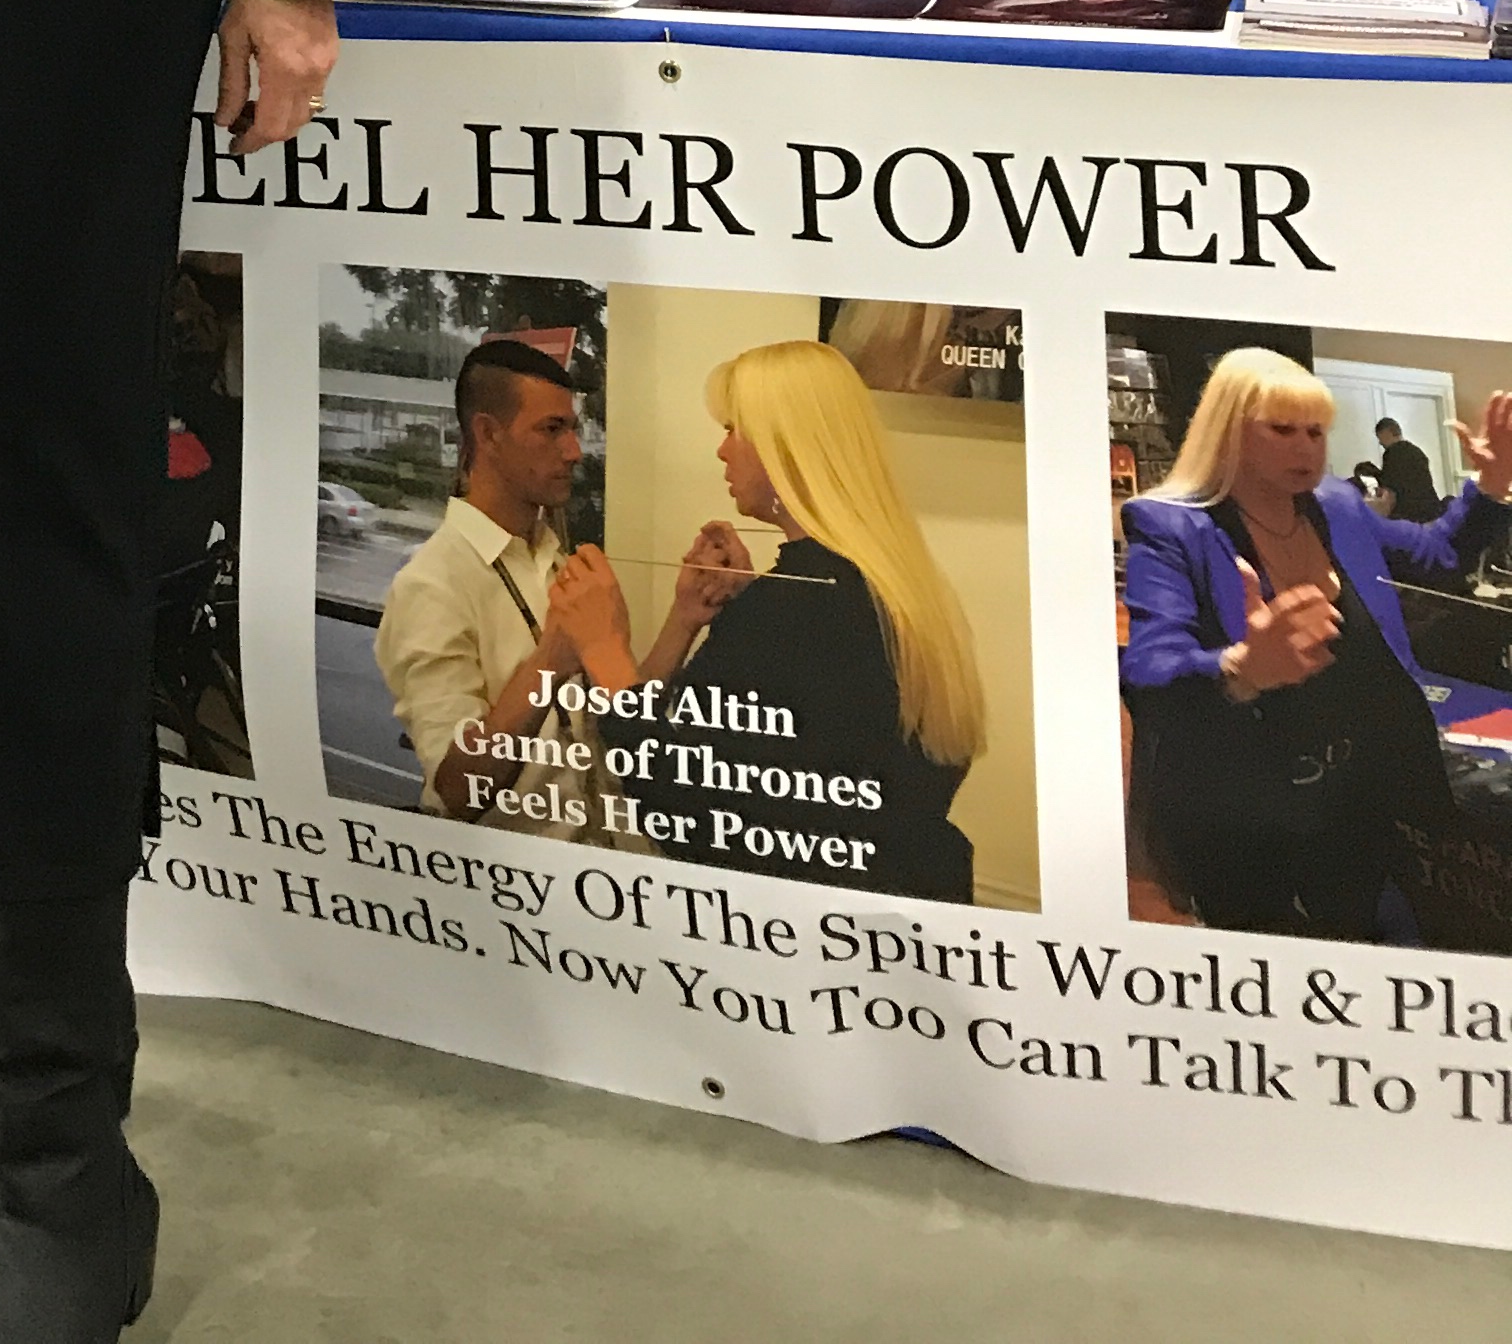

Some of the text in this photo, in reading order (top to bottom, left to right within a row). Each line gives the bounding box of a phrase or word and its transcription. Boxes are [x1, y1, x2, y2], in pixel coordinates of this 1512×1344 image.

[190, 112, 1336, 273] EEL HER POWER
[941, 344, 1006, 370] QUEEN
[527, 669, 798, 739] Josef Altin
[453, 717, 884, 812] Game of Thrones
[463, 772, 877, 873] Feels Her Power
[212, 791, 327, 856] The
[339, 818, 555, 916] Energy
[574, 868, 653, 930] Of
[667, 884, 799, 958] The
[819, 911, 1019, 993] Spirit
[1036, 939, 1274, 1021] World
[1301, 968, 1363, 1029] &
[1384, 975, 1512, 1043] Pla
[137, 840, 259, 906] Your
[272, 868, 487, 958] Hands.
[499, 918, 647, 996] Now
[658, 957, 796, 1037] You
[811, 985, 947, 1043] Too
[967, 1017, 1105, 1084] Can
[1127, 1033, 1296, 1102] Talk
[1315, 1053, 1418, 1114] To
